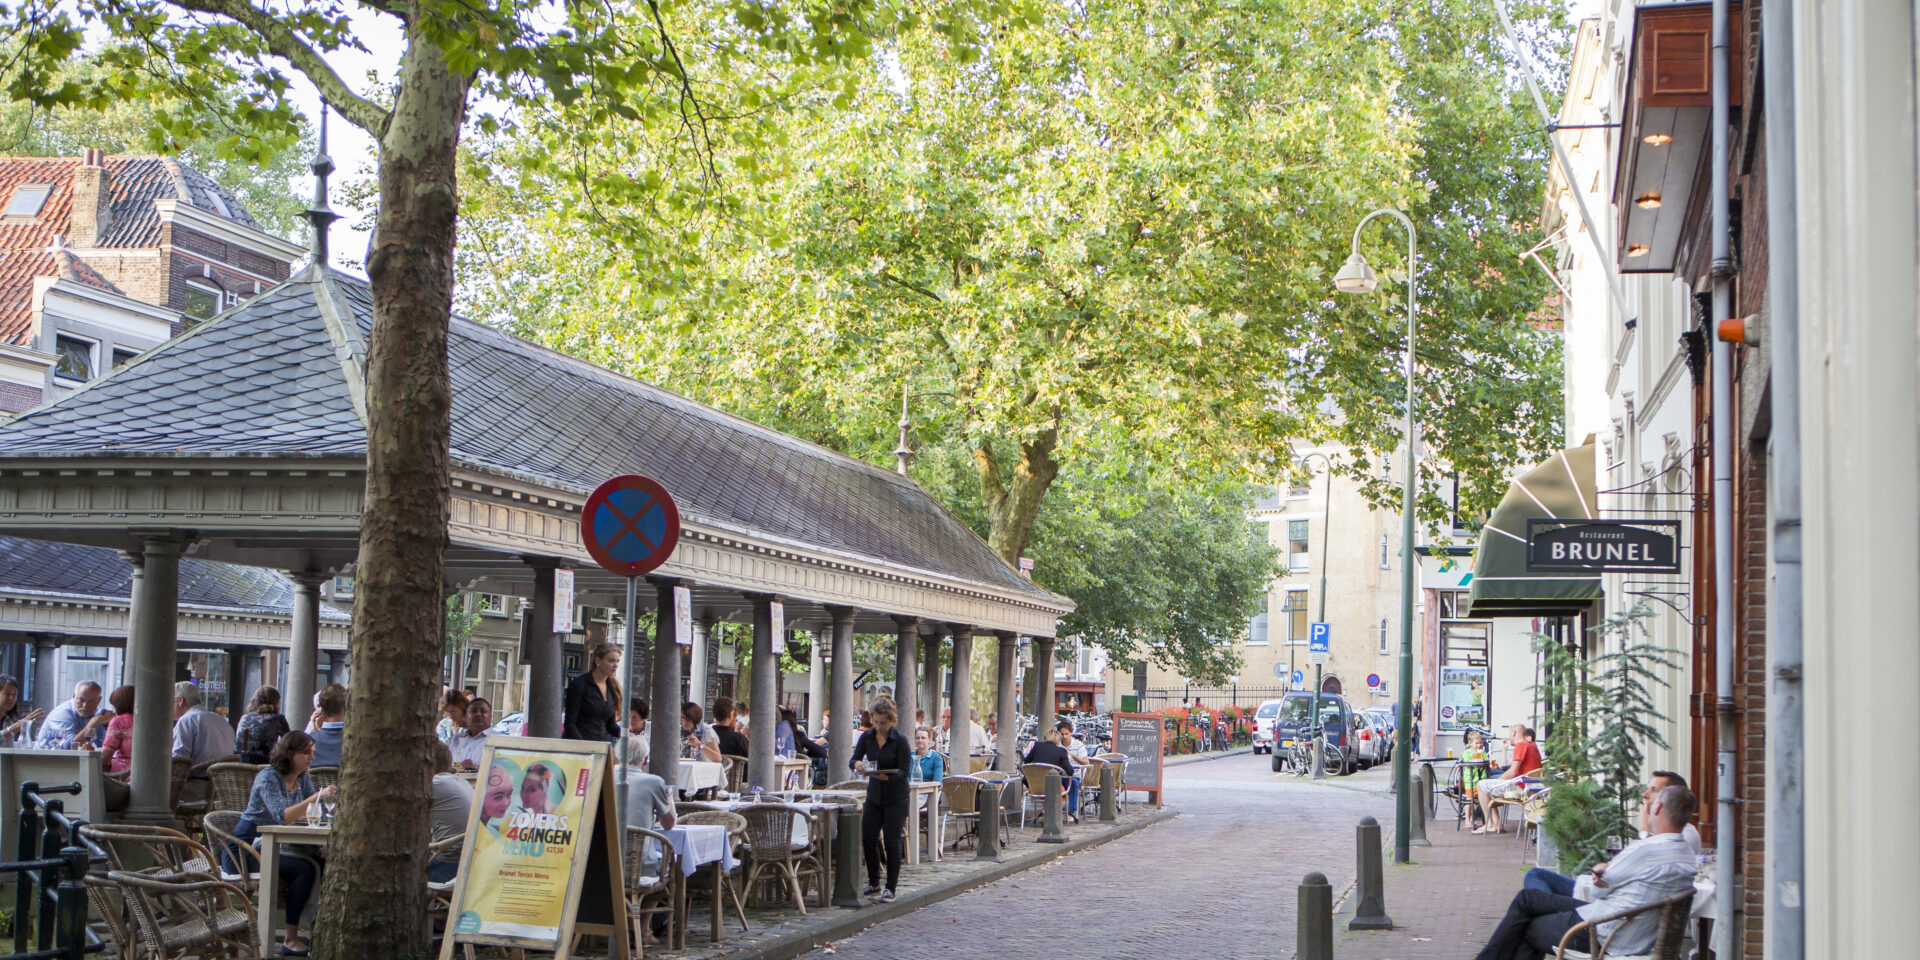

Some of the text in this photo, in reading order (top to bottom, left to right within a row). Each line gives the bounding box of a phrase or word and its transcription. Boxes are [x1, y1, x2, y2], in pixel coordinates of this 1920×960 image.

[1579, 531, 1625, 539] Restaurant
[1551, 542, 1655, 561] BRUNEL
[1313, 624, 1326, 641] P
[508, 811, 569, 830] ZOMERS
[502, 840, 545, 858] MENU
